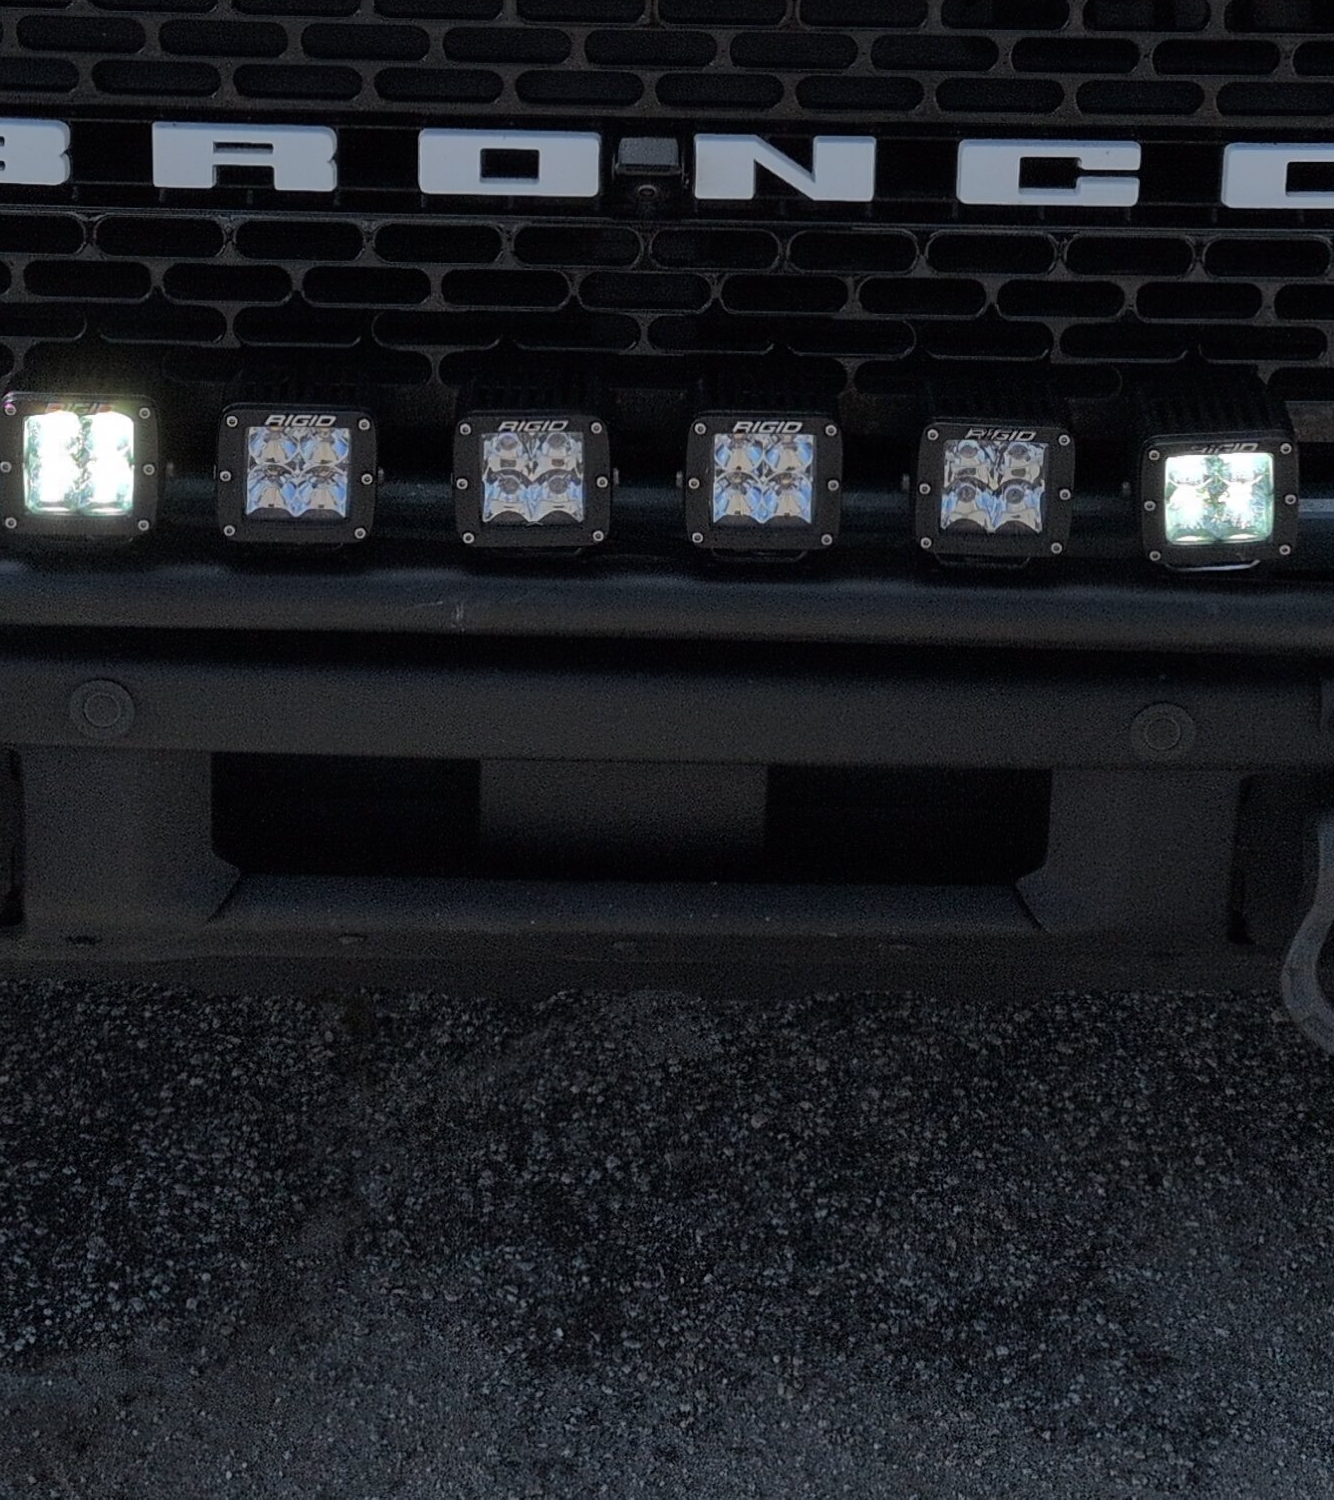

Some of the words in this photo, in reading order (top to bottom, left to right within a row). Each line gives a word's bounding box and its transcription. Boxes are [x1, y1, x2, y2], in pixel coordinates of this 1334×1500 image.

[265, 415, 336, 427] RIGID
[497, 420, 569, 432] RIGID
[732, 421, 804, 434] RIGID
[964, 427, 1037, 441] RIGID
